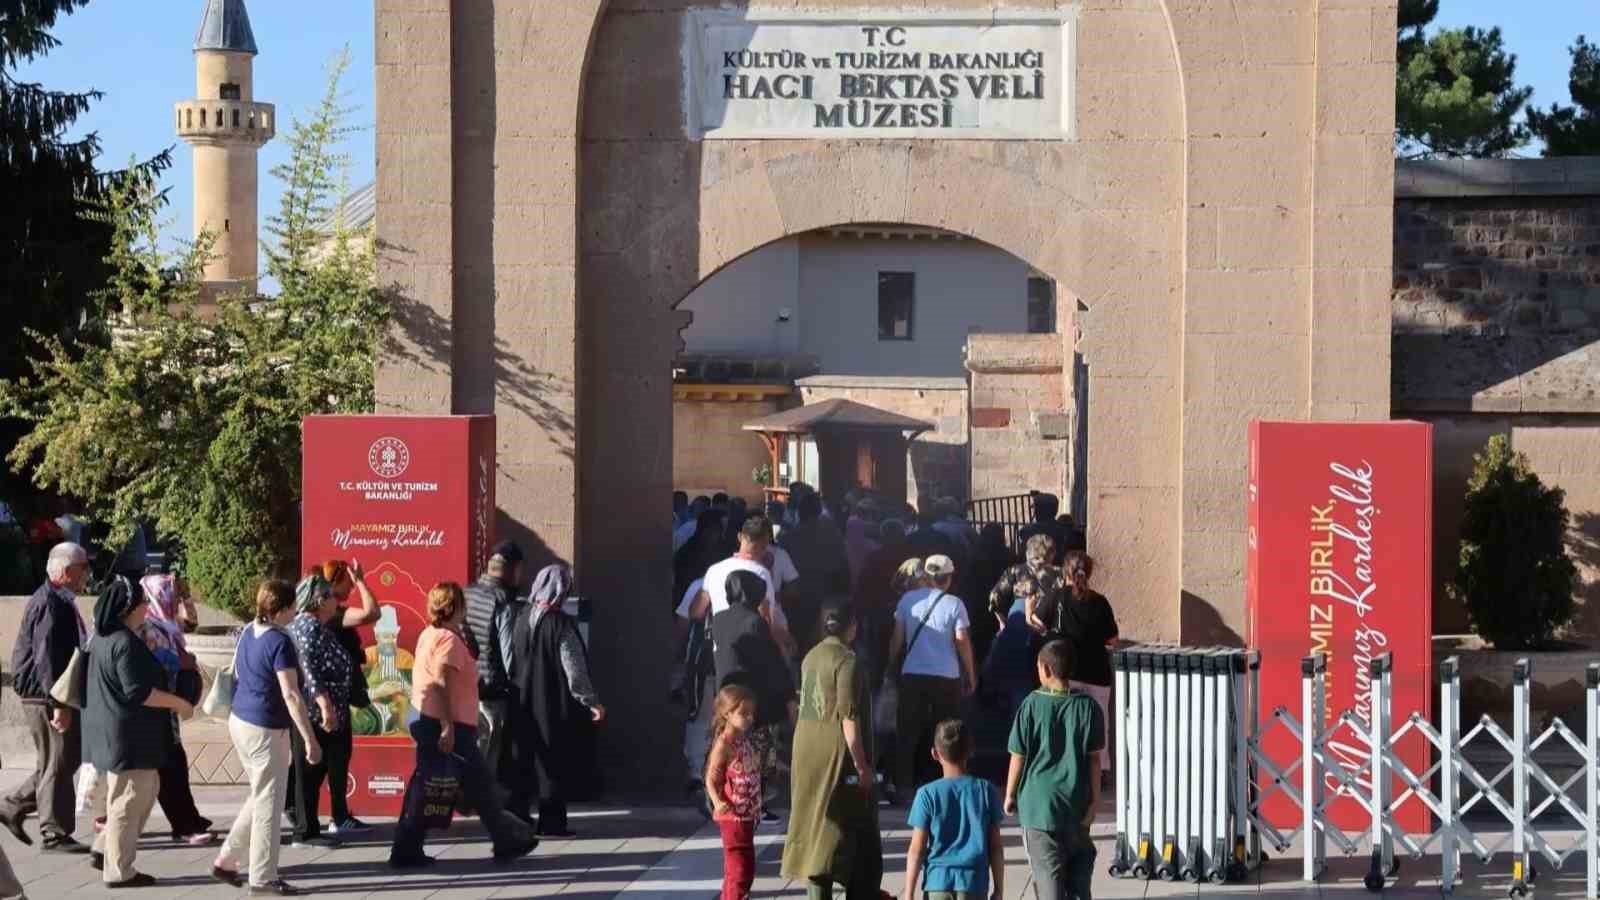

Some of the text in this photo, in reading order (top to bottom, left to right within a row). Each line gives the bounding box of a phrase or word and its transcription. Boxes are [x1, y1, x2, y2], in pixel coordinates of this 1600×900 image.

[862, 27, 907, 47] T.C
[723, 48, 807, 69] KÜLTÜR
[835, 50, 921, 69] TURİZM
[928, 48, 1044, 69] BAKANLIĞI
[723, 74, 815, 99] HACI
[966, 69, 1045, 99] VELİ
[813, 99, 953, 128] MÜZESİ
[339, 481, 438, 491] T.C. KÜLTÜR VE TURİZM
[365, 491, 412, 500] BAKANLIĞI
[351, 524, 396, 533] MAYAMIZ
[1329, 459, 1382, 618] Kardeşlik
